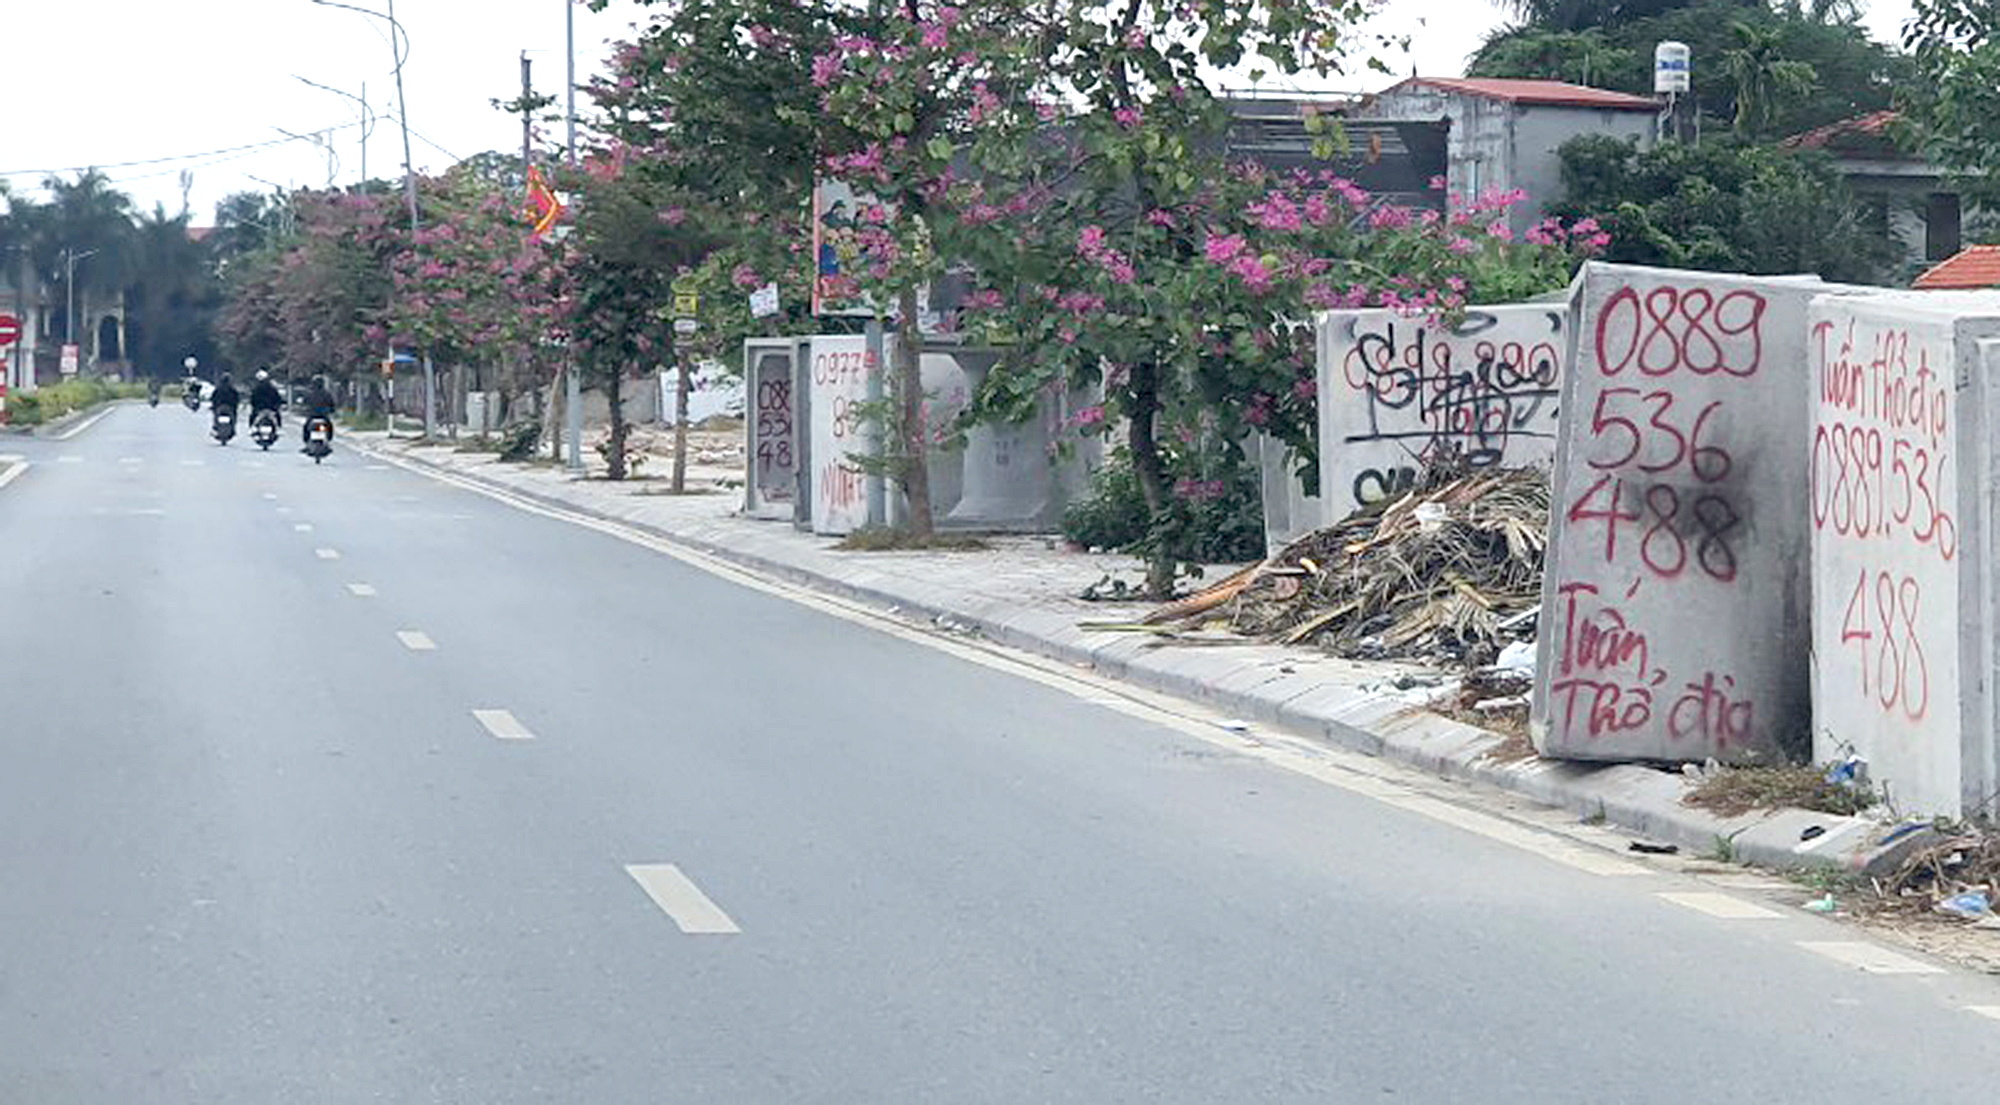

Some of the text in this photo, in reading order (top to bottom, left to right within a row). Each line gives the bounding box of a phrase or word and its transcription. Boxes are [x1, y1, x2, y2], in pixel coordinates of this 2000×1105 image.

[1595, 284, 1766, 377] 0889
[1587, 386, 1731, 483] 536
[1566, 474, 1741, 582] 488
[1841, 566, 1928, 722] 488
